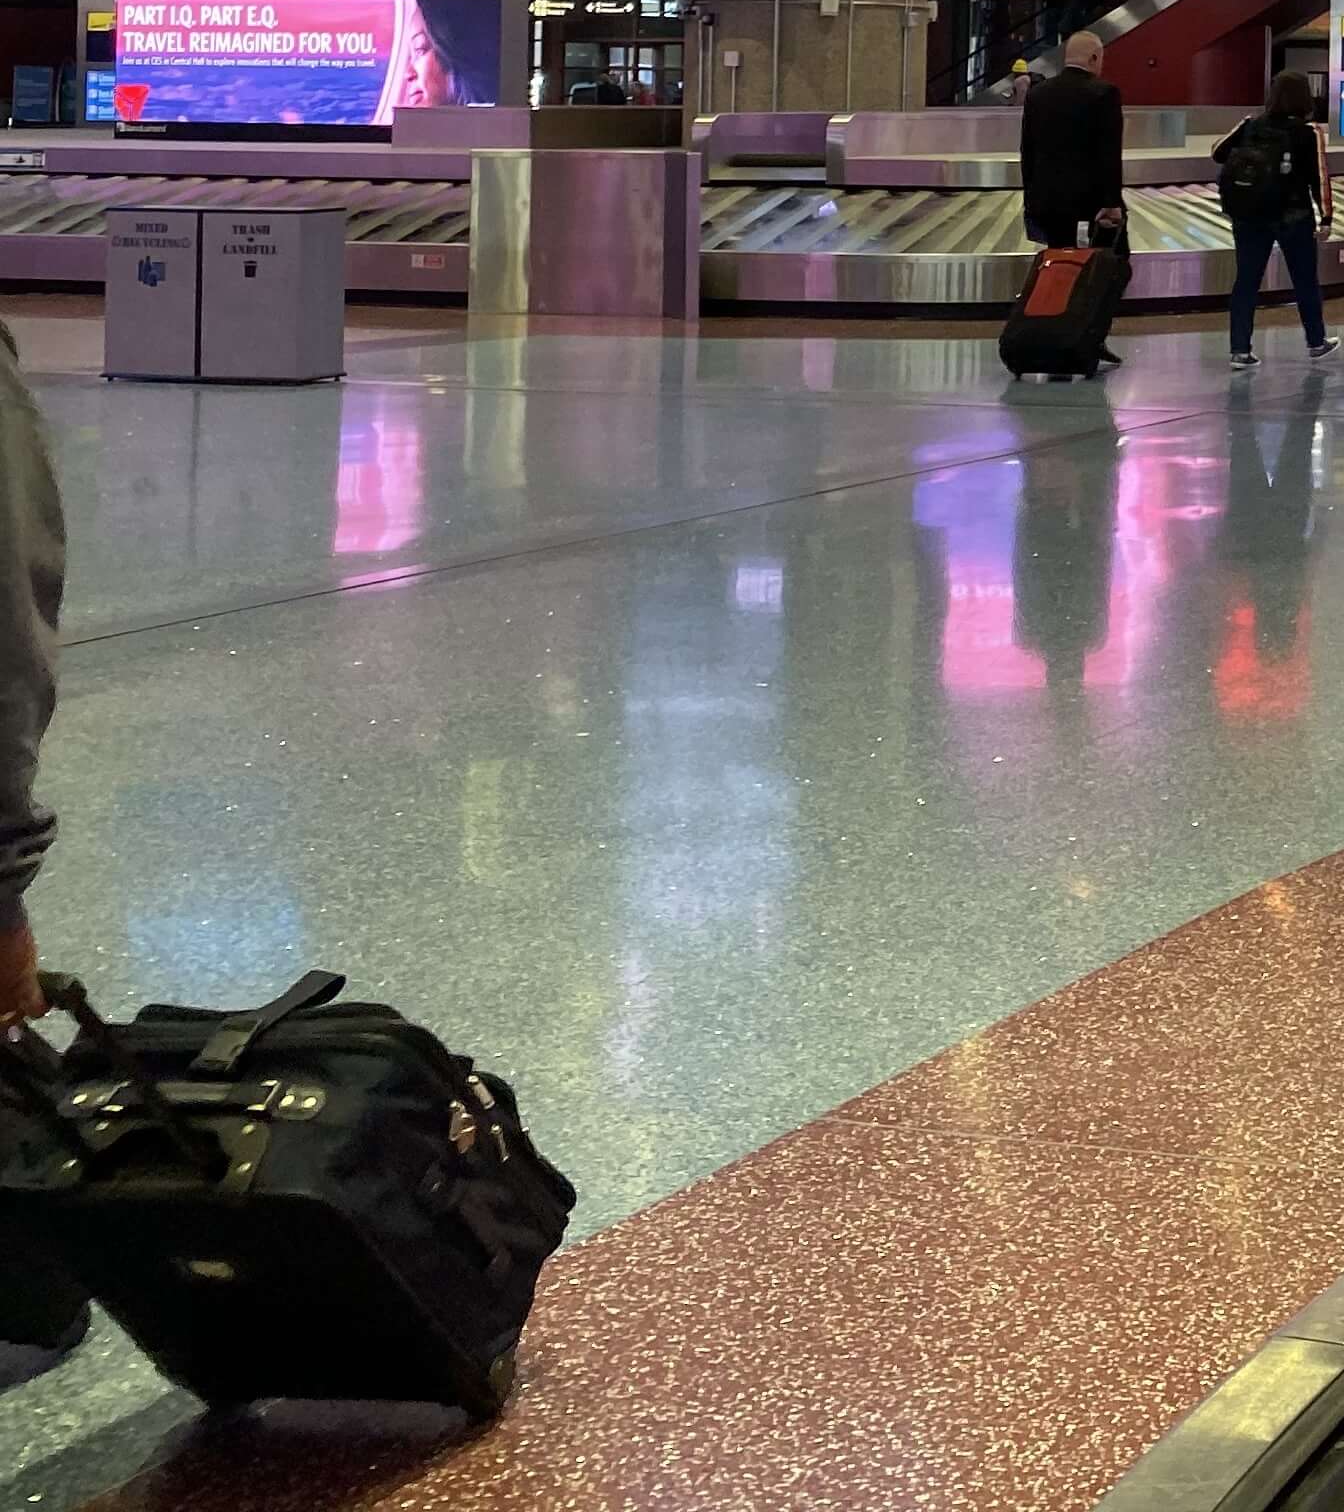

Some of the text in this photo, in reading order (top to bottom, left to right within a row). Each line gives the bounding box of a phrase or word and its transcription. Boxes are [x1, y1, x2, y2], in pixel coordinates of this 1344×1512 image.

[124, 5, 279, 28] PART I.Q. PART E.Q.
[123, 31, 377, 54] TRAVEL REIMAGINED FOR YOU.
[136, 223, 168, 234] MIXED
[232, 225, 270, 235] TRASH
[223, 245, 277, 255] LANDFILL
